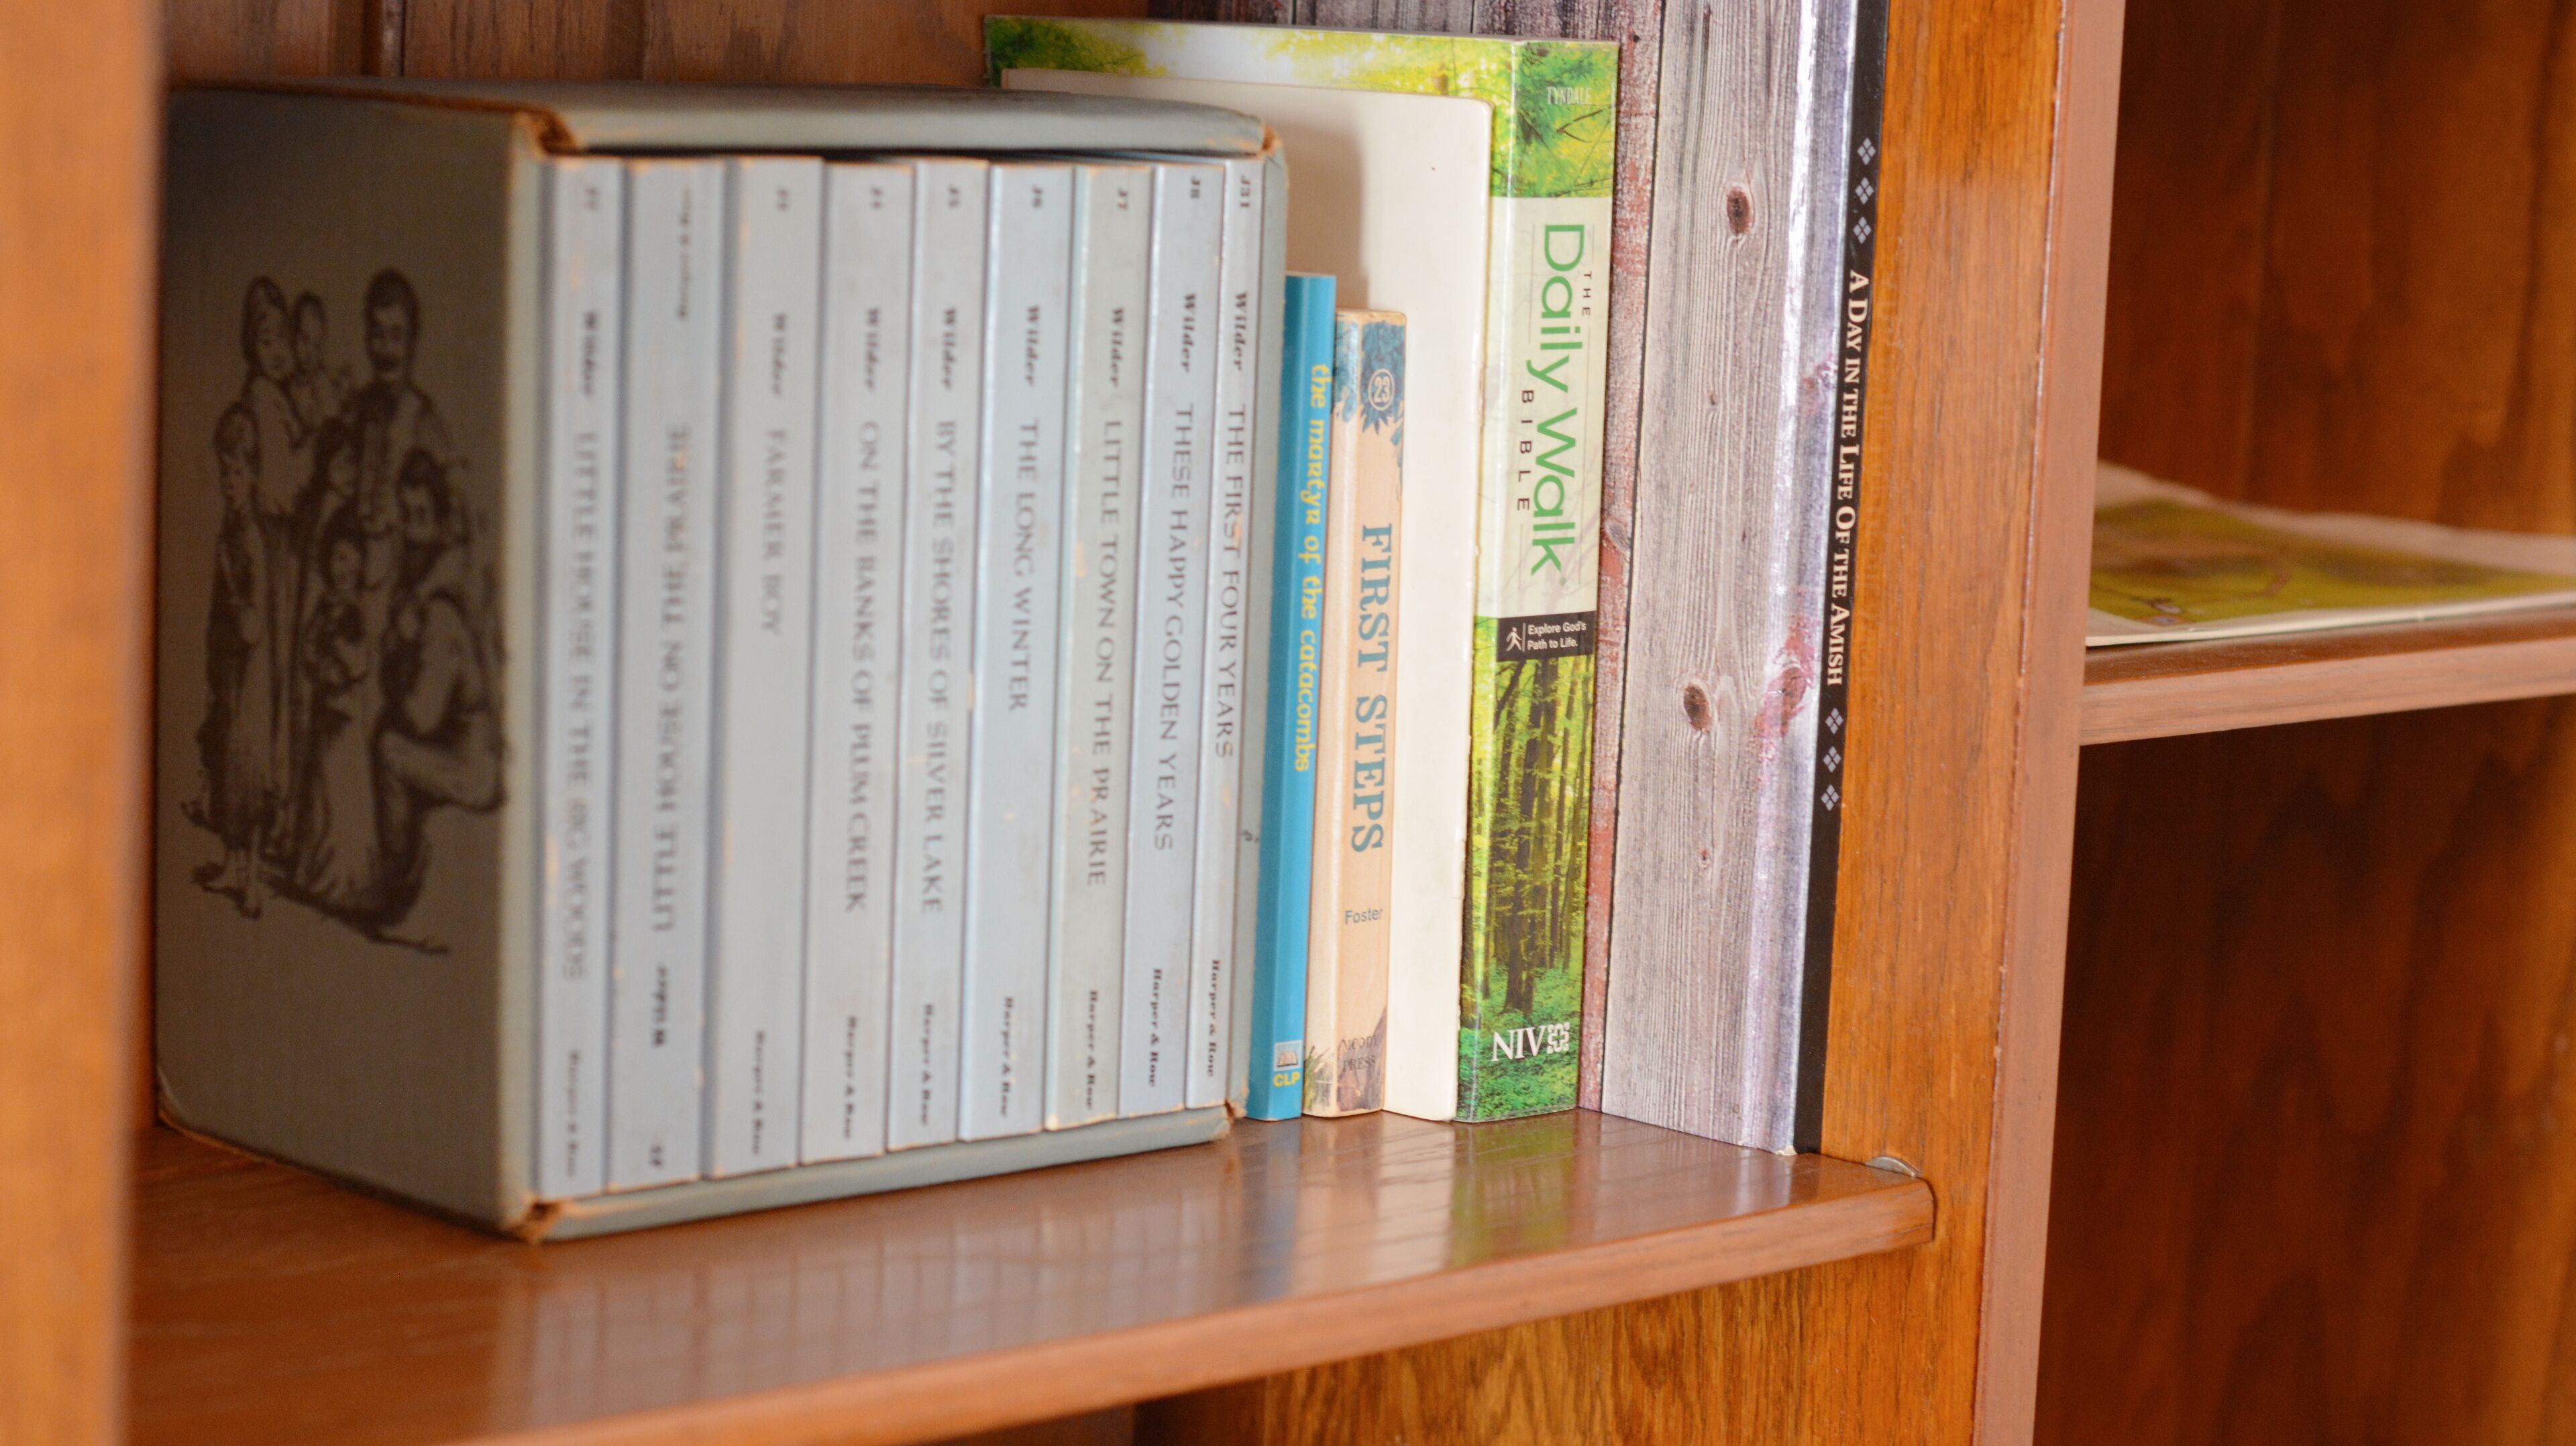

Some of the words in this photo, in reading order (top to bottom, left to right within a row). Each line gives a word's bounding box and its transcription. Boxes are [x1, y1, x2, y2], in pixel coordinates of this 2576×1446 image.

[1546, 86, 1592, 105] TYNDALE
[1526, 225, 1585, 393] Daily
[1582, 271, 1593, 317] THE
[1849, 269, 1869, 294] A
[943, 307, 957, 390] Wilder
[1024, 305, 1040, 386] Wilder
[1109, 307, 1124, 387] Wilder
[1180, 292, 1195, 372] Wilder
[1232, 291, 1247, 370] Wilder
[1845, 299, 1868, 352] DAY
[1311, 364, 1331, 409] the
[1375, 376, 1391, 403] 23
[1844, 358, 1860, 384] IN
[935, 420, 956, 457] BY
[1226, 404, 1245, 464] THE
[1841, 389, 1858, 439] THE
[859, 421, 881, 471] ON
[1018, 417, 1037, 481] THE
[1102, 421, 1122, 525] LITTLE
[1171, 403, 1193, 499] THESE
[1517, 390, 1535, 511] BIBLE
[1837, 444, 1860, 501] LIFE
[763, 429, 788, 559] FARMER
[856, 479, 881, 544] THE
[933, 466, 955, 527] THE
[1222, 476, 1243, 558] FIRST
[1835, 506, 1856, 544] OF
[1013, 492, 1036, 576] LONG
[1166, 509, 1188, 609] HAPPY
[1298, 535, 1322, 564] of
[762, 573, 786, 635] BOY
[928, 537, 954, 662] SHORES
[1097, 533, 1118, 629] TOWN
[1301, 576, 1322, 620] the
[1358, 523, 1393, 673] FIRST
[1831, 549, 1849, 598] THE
[854, 556, 877, 662] BANKS
[1220, 570, 1239, 652] FOUR
[1527, 623, 1561, 636] Explore
[1563, 620, 1587, 633] God's
[659, 639, 683, 692] ON
[1011, 587, 1032, 711] WINTER
[1095, 636, 1114, 683] ON
[1527, 639, 1547, 650] Path
[1548, 639, 1558, 648] to
[1560, 637, 1578, 648] Life.
[1827, 603, 1850, 685] AMISH
[850, 669, 874, 713] OF
[926, 670, 949, 711] OF
[1160, 616, 1183, 739] GOLDEN
[1295, 629, 1317, 772] catacombs
[1091, 693, 1113, 756] THE
[1216, 662, 1236, 758] YEARS
[848, 723, 871, 805] PLUM
[923, 721, 947, 823] SILVER
[1351, 694, 1388, 853] STEPS
[1087, 768, 1110, 886] PRAIRIE
[1154, 754, 1177, 851] YEARS
[847, 811, 869, 913] CREEK
[921, 835, 944, 915] LAKE
[1345, 908, 1383, 925] Foster
[1086, 990, 1097, 1052] Harper
[1148, 968, 1162, 1030] Harper
[1207, 960, 1219, 1019] Harper
[1148, 1051, 1159, 1087] Row
[1207, 1042, 1216, 1076] Row
[1491, 1025, 1547, 1062] NIV
[1273, 1072, 1300, 1088] CLP
